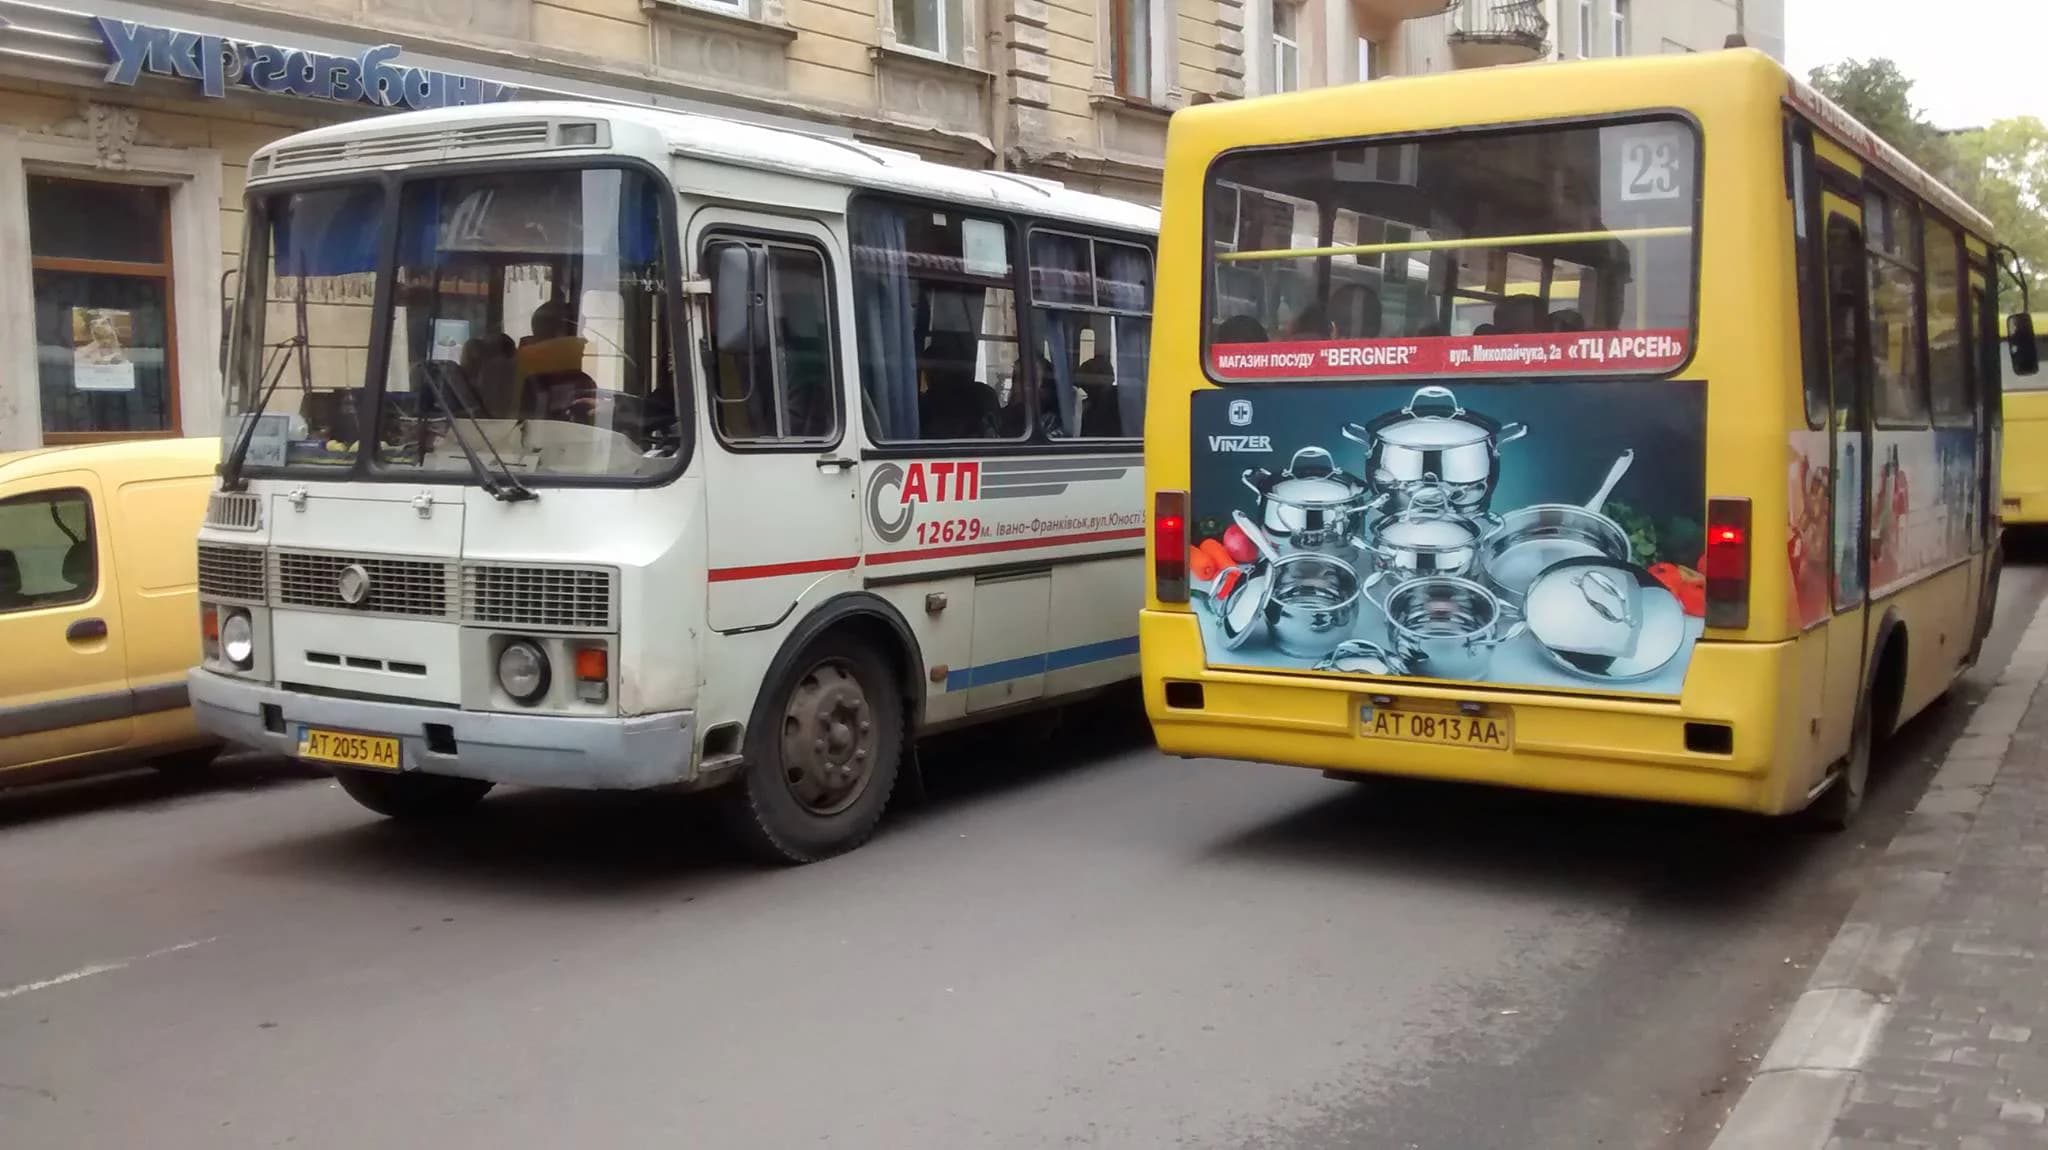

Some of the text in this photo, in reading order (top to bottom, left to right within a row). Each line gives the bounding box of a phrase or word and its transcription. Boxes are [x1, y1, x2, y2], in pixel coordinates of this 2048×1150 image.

[1629, 143, 1680, 194] 23
[1219, 354, 1269, 369] МАГАЗИН
[1270, 352, 1315, 369] ПОСУДУ
[1450, 348, 1471, 366] вул.
[1549, 344, 1562, 360] 2а
[1609, 336, 1682, 359] АРСЕН»
[917, 517, 981, 545] 12629
[1411, 715, 1462, 741] 0813
[333, 736, 369, 760] 2055
